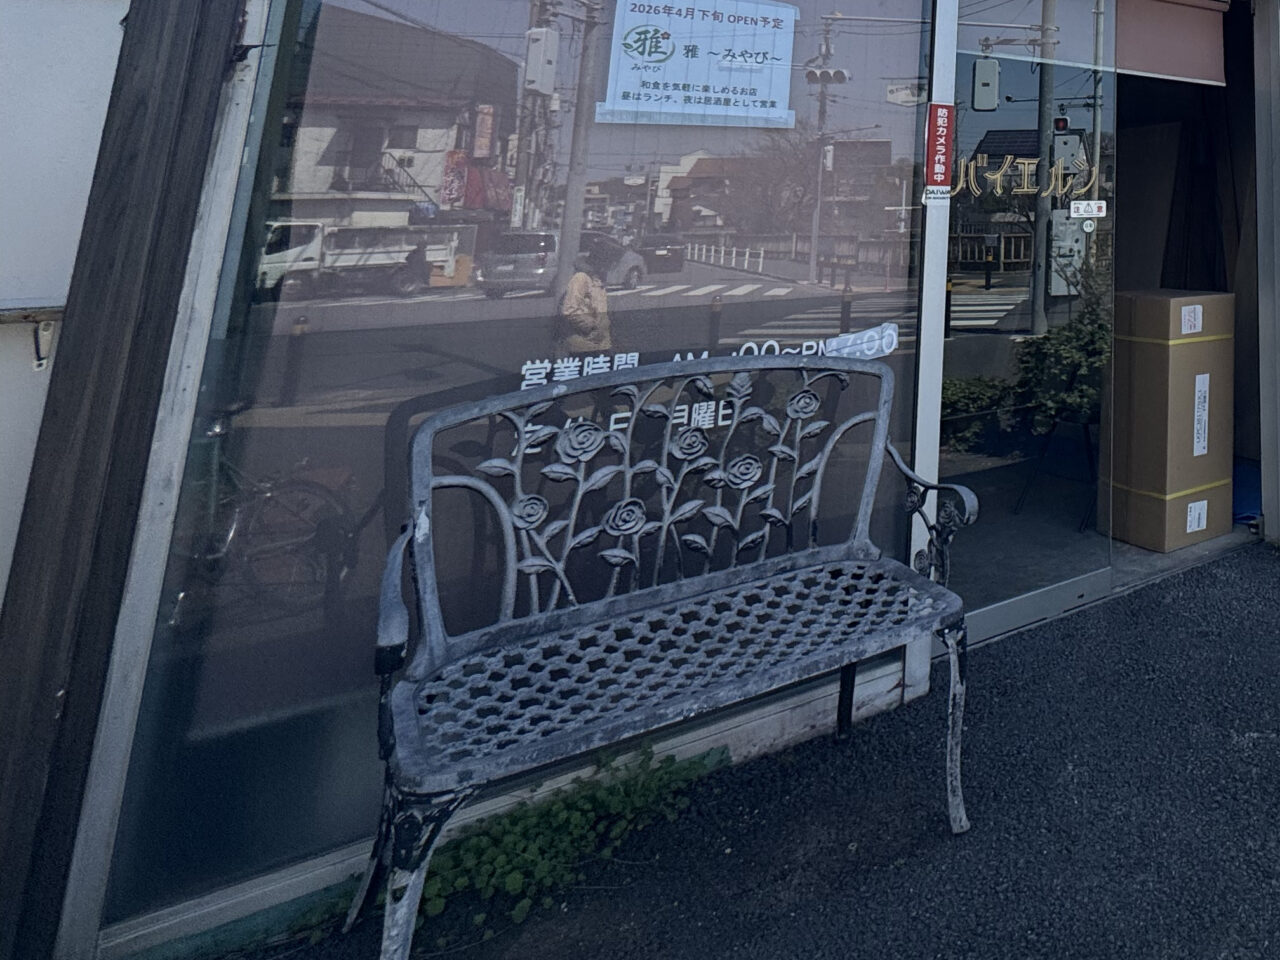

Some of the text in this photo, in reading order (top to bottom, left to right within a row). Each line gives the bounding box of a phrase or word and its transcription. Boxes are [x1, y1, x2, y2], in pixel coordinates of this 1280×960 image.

[630, 3, 784, 30] 2026年4月下旬 OPEN予定
[632, 28, 668, 57] 雅
[683, 44, 700, 59] 雅
[631, 63, 662, 73] みやび
[640, 80, 758, 97] 和食を気軽に楽しめるお店
[621, 91, 778, 109] 昼はランチ。夜は居酒屋として営業
[933, 108, 949, 183] 防犯カメラ作動中
[949, 153, 1097, 198] バイエルン
